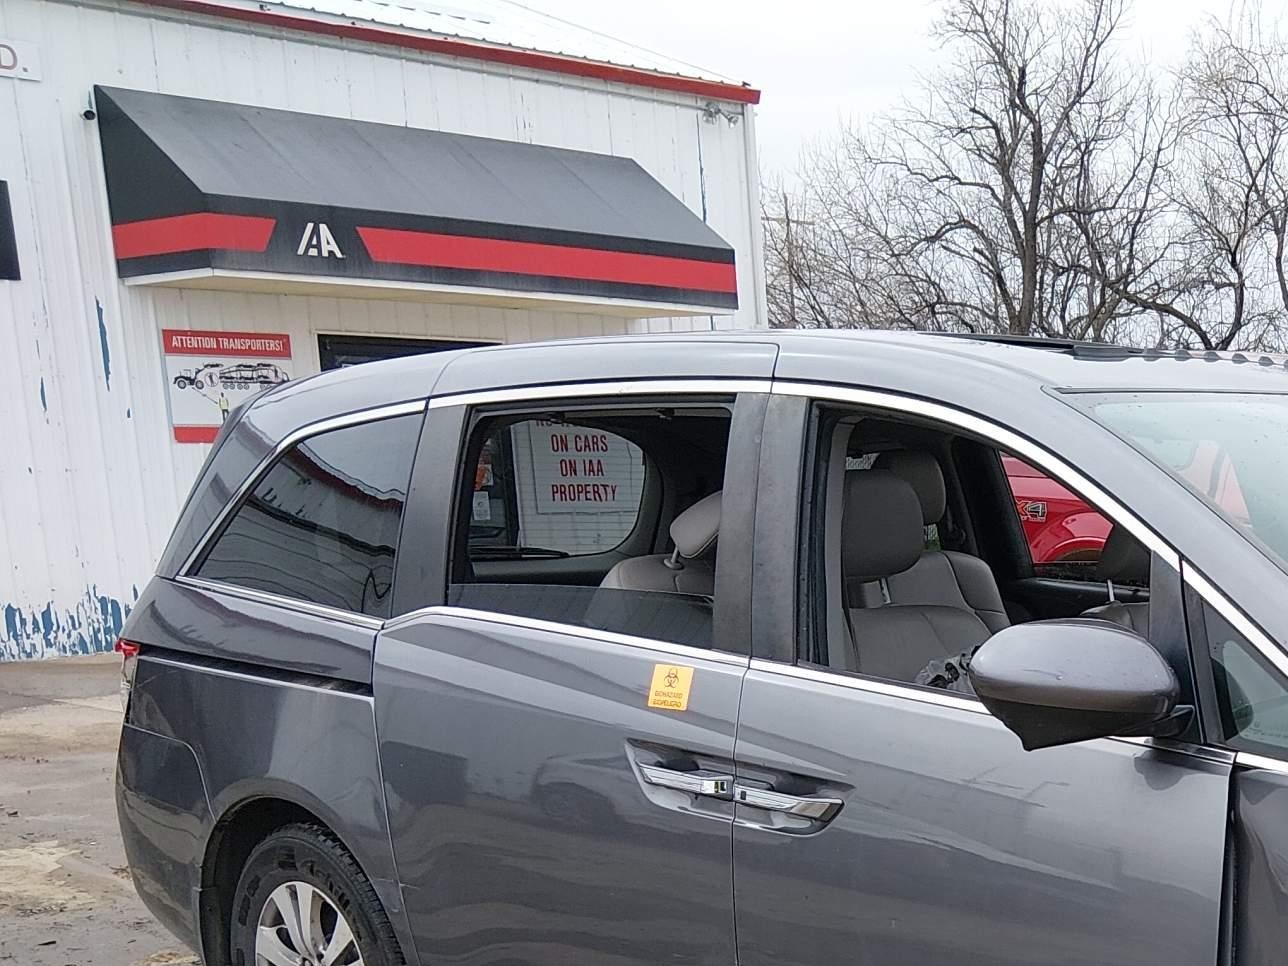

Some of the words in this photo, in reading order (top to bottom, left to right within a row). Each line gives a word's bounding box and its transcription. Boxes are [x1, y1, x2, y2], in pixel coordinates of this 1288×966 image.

[172, 336, 217, 349] ATTENTION
[218, 337, 283, 351] TRANSPORTERS!
[551, 434, 569, 452] ON
[574, 434, 608, 453] CARS
[559, 459, 577, 477] ON
[583, 459, 604, 477] IAA
[552, 483, 617, 503] PROPERTY
